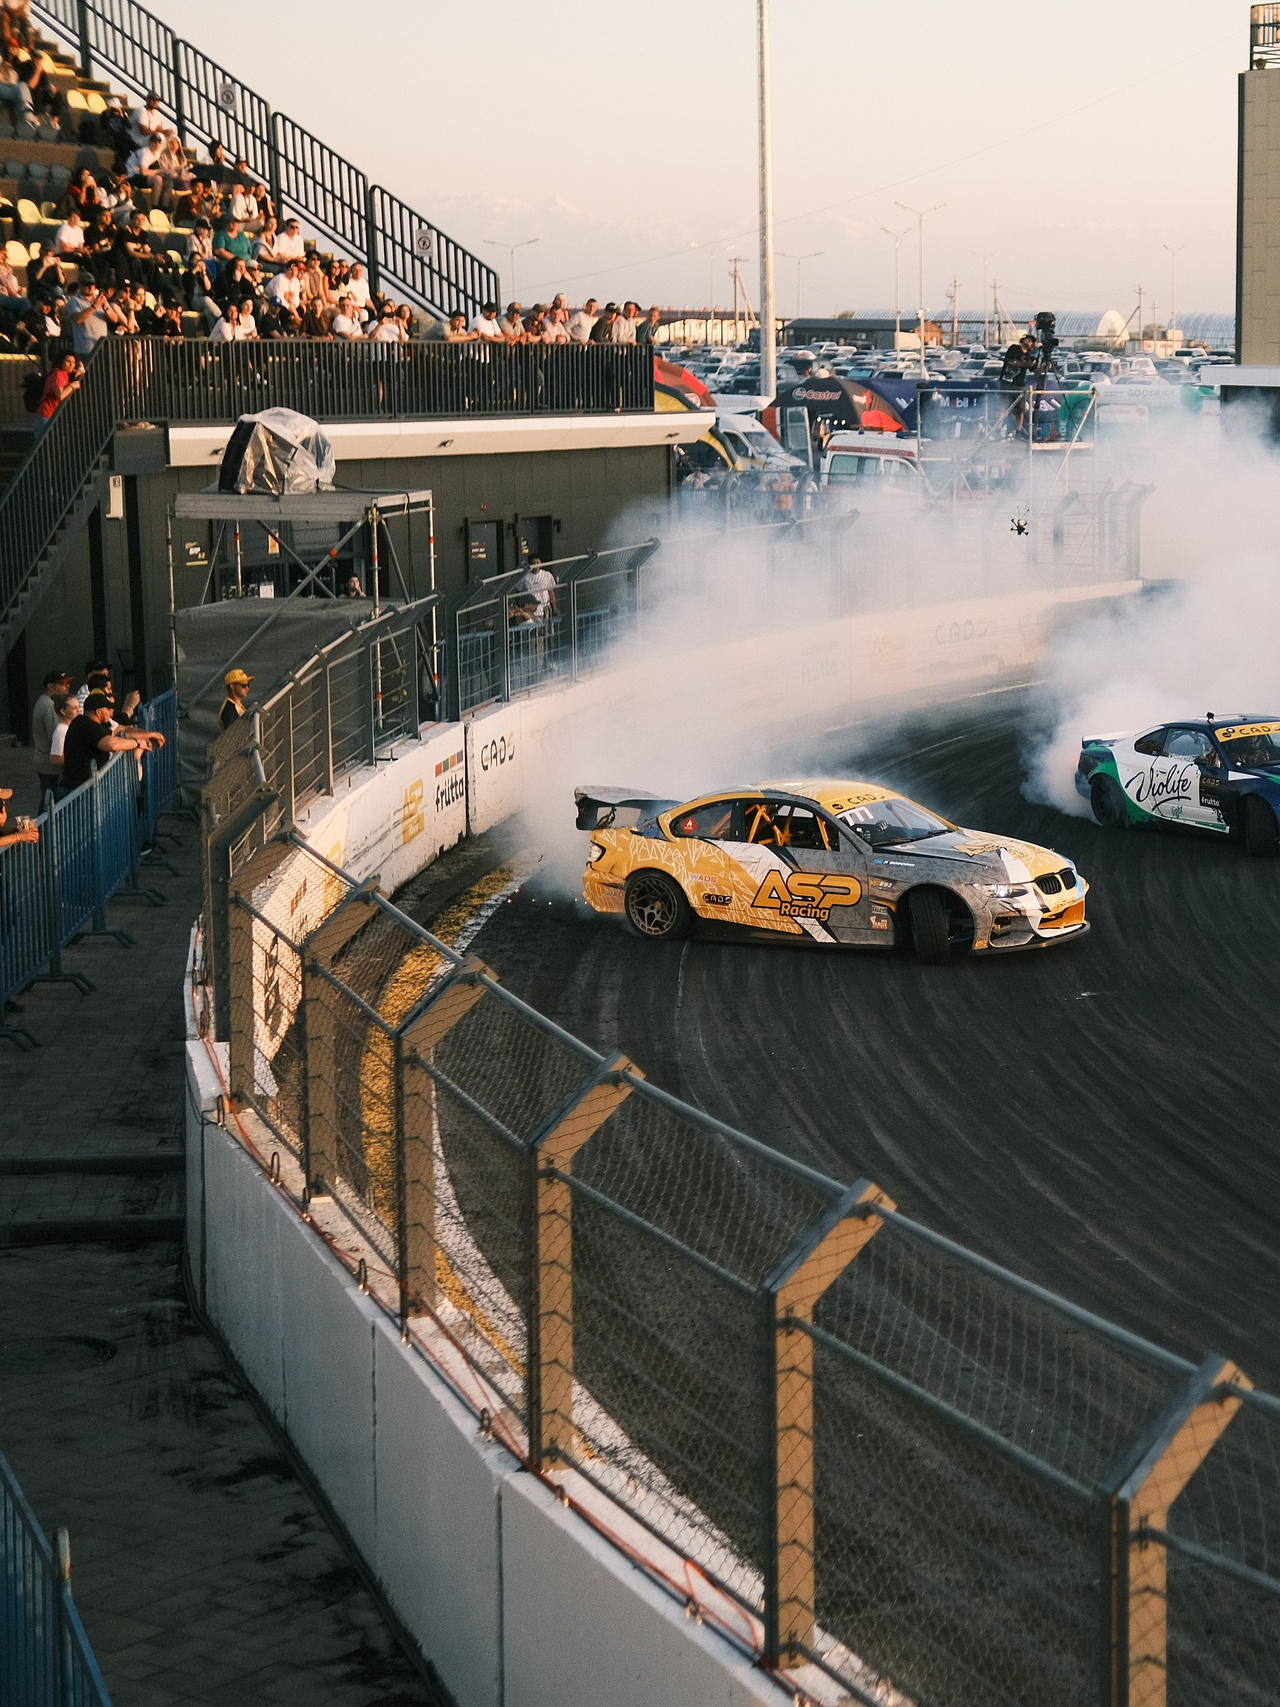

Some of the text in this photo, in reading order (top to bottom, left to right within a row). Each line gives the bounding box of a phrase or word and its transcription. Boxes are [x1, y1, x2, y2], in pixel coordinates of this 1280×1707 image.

[805, 389, 843, 400] Castrol
[1127, 389, 1177, 397] GOODRIDE
[940, 397, 969, 408] Mobil
[480, 730, 516, 772] CADS
[1125, 763, 1192, 802] Violife
[435, 773, 464, 814] frütta
[690, 873, 717, 883] WADS
[751, 869, 862, 910] ASP
[703, 893, 732, 904] CADS
[780, 902, 830, 922] Racing
